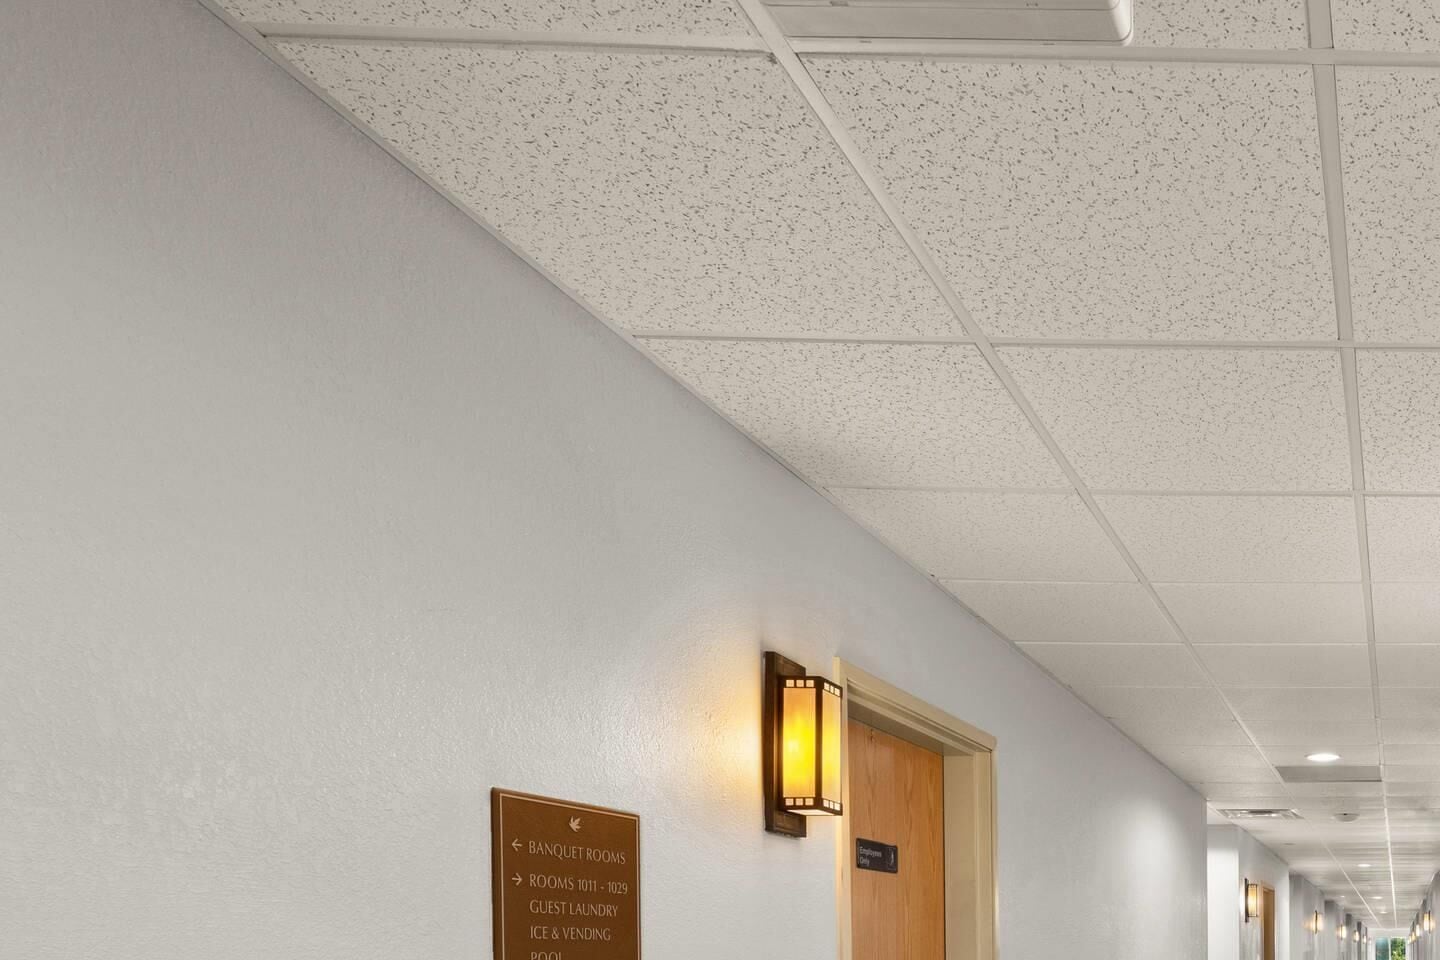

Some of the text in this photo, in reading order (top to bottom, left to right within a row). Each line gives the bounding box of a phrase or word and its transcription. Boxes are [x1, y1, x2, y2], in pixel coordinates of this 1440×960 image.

[528, 840, 626, 865] BANQUET ROOMS
[529, 873, 574, 890] ROOMS
[577, 879, 597, 892] 1011
[607, 881, 628, 895] 1029
[529, 899, 618, 917] GUEST LAUNDRY
[530, 925, 611, 941] ICE & VENDING
